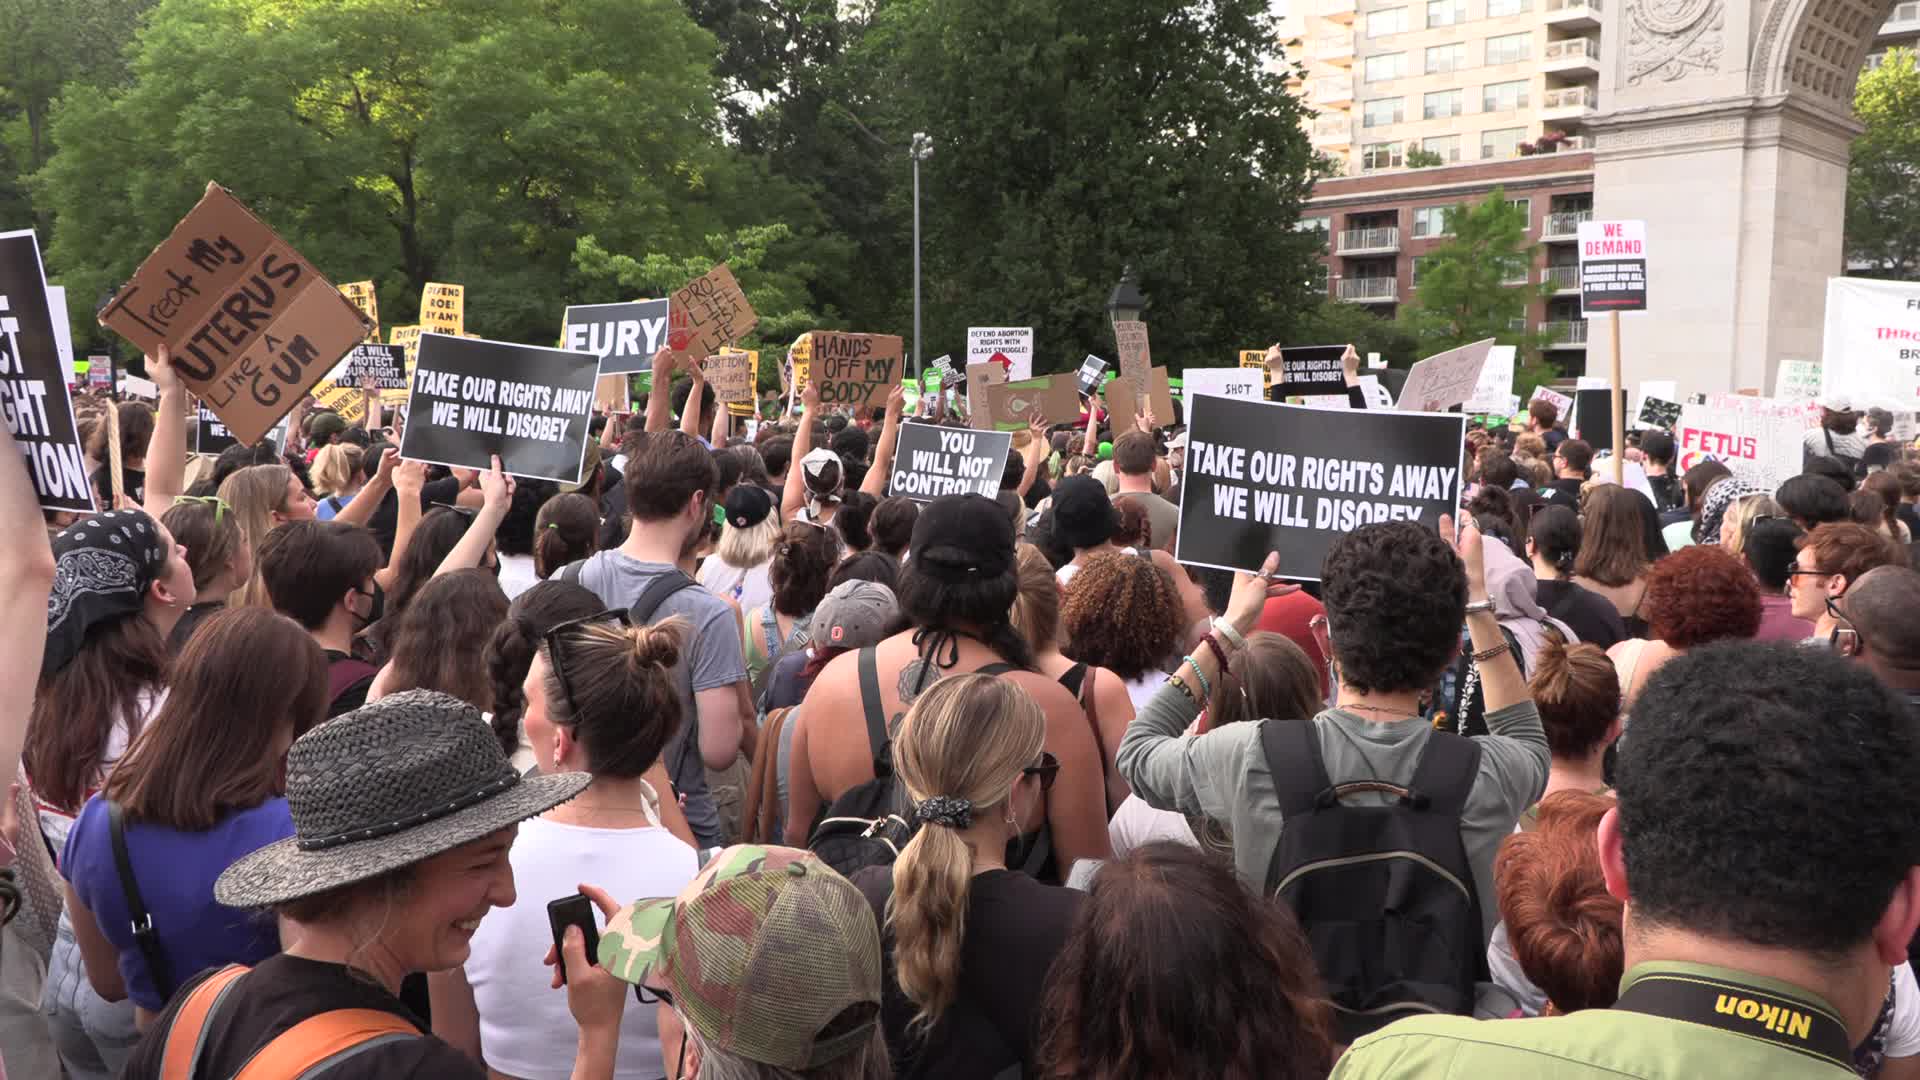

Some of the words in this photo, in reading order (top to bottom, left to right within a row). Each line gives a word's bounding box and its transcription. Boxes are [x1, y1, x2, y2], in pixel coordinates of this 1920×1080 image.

[1604, 224, 1623, 237] WE
[1585, 240, 1641, 256] DEMAND
[104, 269, 201, 338] Treat
[427, 287, 460, 297] DEFEND
[430, 299, 455, 309] ROE!
[689, 286, 737, 327] LIFE
[175, 253, 302, 382] UTERUS
[426, 311, 436, 320] BY
[438, 312, 459, 321] ANY
[702, 324, 737, 352] LIE
[814, 335, 872, 360] HANDS
[367, 346, 391, 357] WILL
[1246, 352, 1267, 361] ONLY
[251, 334, 321, 407] GUN
[368, 367, 400, 378] RIGHT
[824, 357, 861, 378] OFF
[865, 358, 895, 380] MY
[1292, 361, 1305, 371] OUR
[1307, 360, 1330, 370] RIGHTS
[1294, 372, 1310, 382] WILL
[1312, 371, 1342, 381] DISOBEY
[417, 369, 459, 398] TAKE
[462, 376, 496, 404] OUR
[499, 381, 551, 411] RIGHTS
[552, 388, 592, 415] AWAY
[820, 380, 876, 403] BODY
[1225, 384, 1253, 395] SHOT
[432, 401, 460, 427] WE
[463, 406, 502, 434] WILL
[506, 412, 570, 443] DISOBEY
[940, 431, 976, 455] YOU
[1682, 428, 1757, 459] FETUS
[912, 450, 953, 475] WILL
[958, 456, 993, 478] NOT
[1191, 441, 1245, 480] TAKE
[1250, 450, 1296, 487] OUR
[1301, 456, 1383, 496] RIGHTS
[1389, 464, 1456, 500] AWAY
[977, 480, 999, 500] US
[1214, 484, 1248, 520] WE
[1254, 490, 1308, 528] WILL
[1315, 498, 1423, 532] DISOBEY
[1714, 994, 1813, 1040] Nikon
